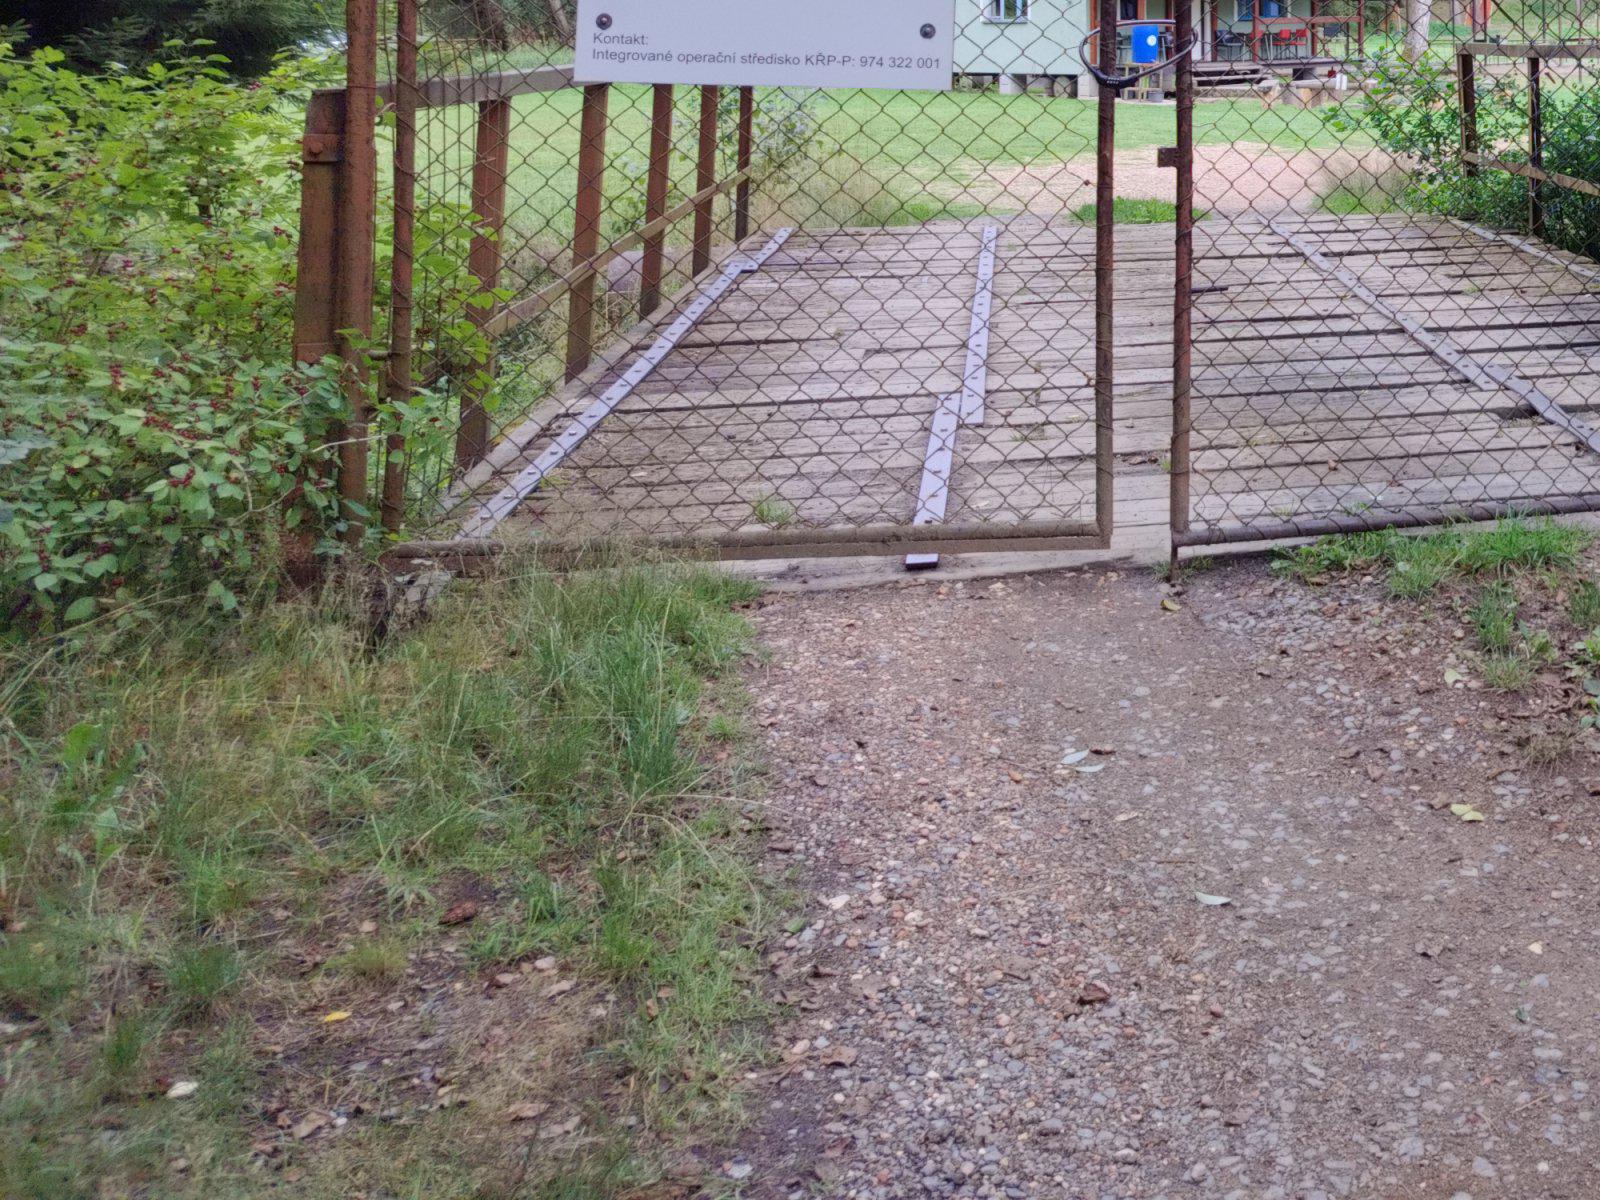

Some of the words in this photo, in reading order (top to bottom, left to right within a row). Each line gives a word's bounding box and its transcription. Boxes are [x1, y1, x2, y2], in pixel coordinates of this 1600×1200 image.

[593, 32, 649, 46] Kontakt:
[592, 49, 673, 63] Integrované
[677, 52, 736, 65] operační
[740, 54, 801, 67] středisko
[859, 57, 885, 69] 974
[888, 57, 914, 69] 322
[916, 57, 941, 70] 001
